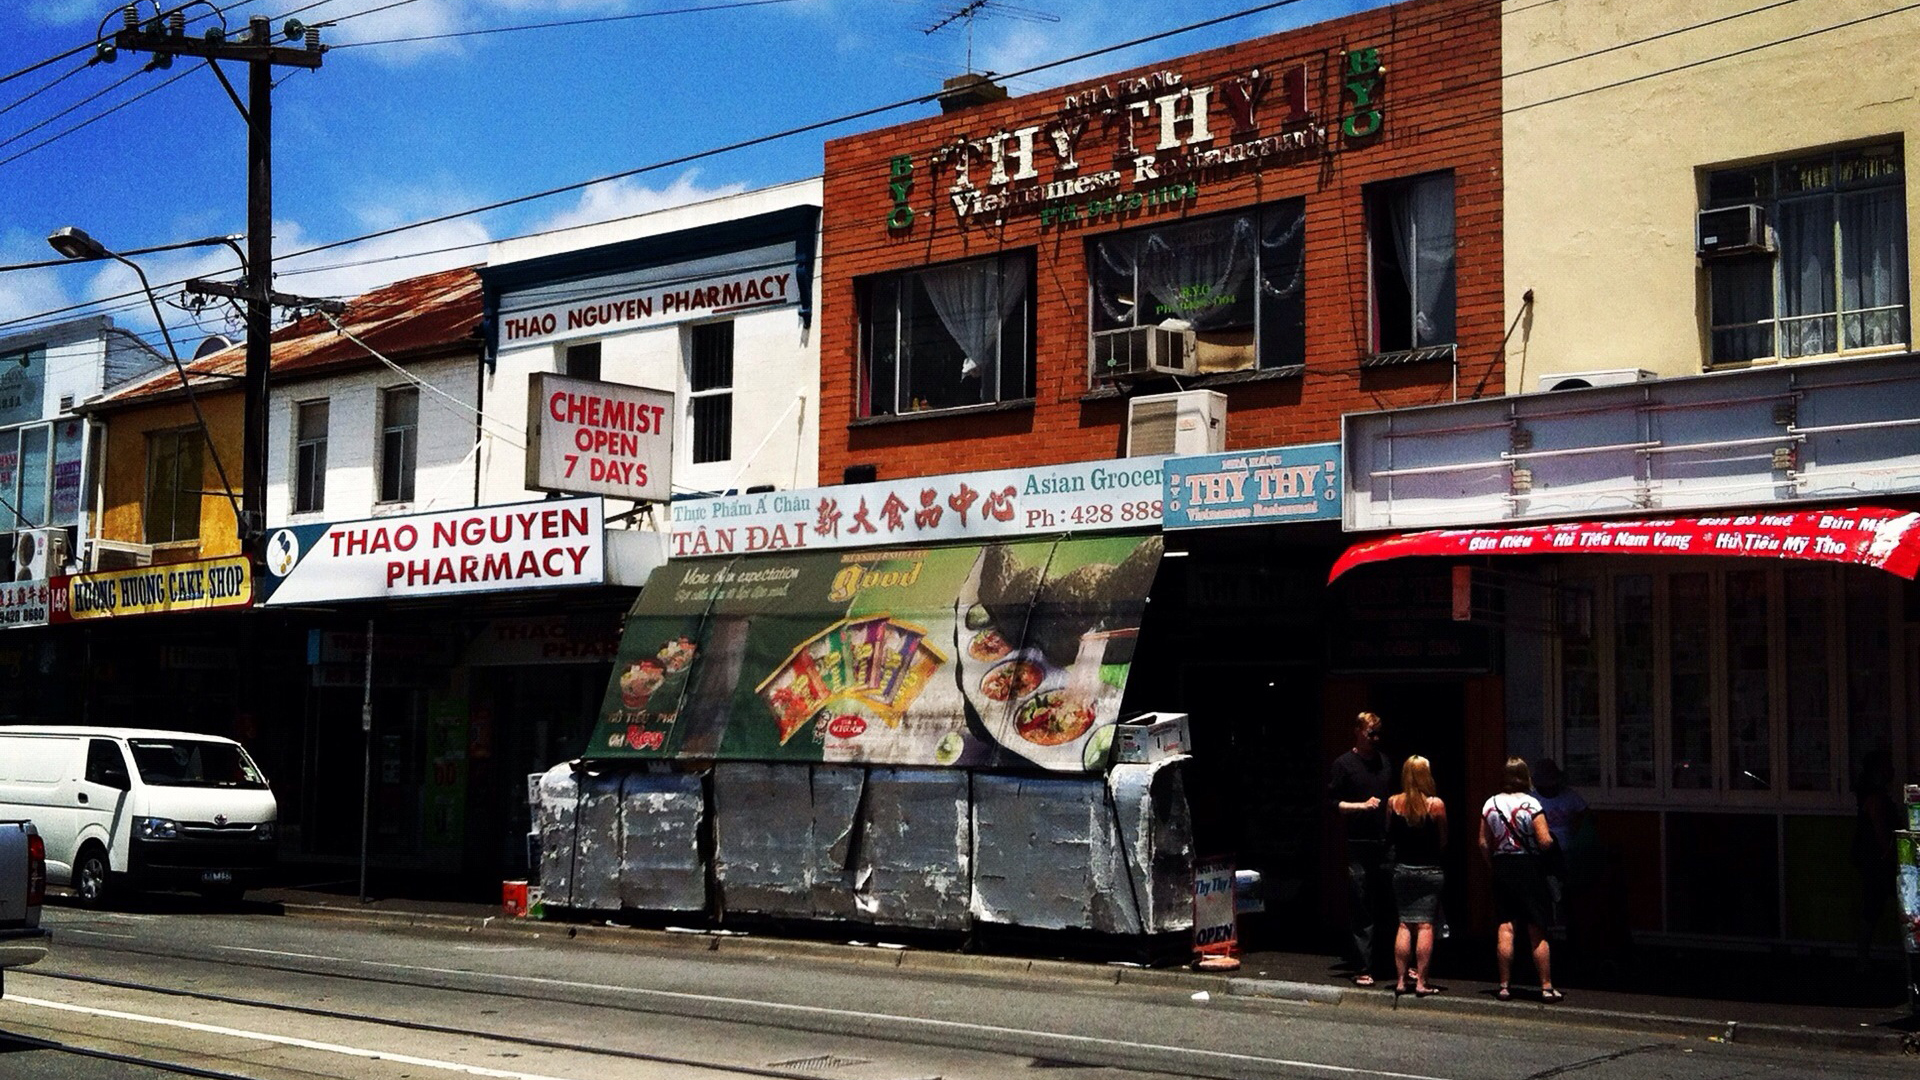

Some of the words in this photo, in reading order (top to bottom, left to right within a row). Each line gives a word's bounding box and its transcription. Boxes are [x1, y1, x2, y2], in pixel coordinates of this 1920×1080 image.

[940, 113, 1091, 193] THY
[505, 314, 556, 341] THAO
[568, 297, 653, 330] NGUYEN
[662, 273, 790, 315] PHARMACY
[549, 391, 665, 435] CHEMIST
[575, 428, 638, 458] OPEN
[564, 455, 579, 479] 7
[590, 457, 648, 488] DAYS
[1023, 472, 1086, 496] Asian
[1186, 471, 1250, 505] THY
[1254, 465, 1320, 500] THY
[774, 496, 810, 513] Châu
[814, 482, 1018, 539] 新大食品中心
[1071, 504, 1113, 524] 428
[330, 524, 418, 557] THAO
[433, 507, 589, 549] NGUYEN
[673, 525, 737, 556] TÂN
[1615, 533, 1649, 547] Nam
[1653, 532, 1692, 550] Vang
[1783, 536, 1810, 554] Mỹ
[387, 546, 590, 588] PHARMACY
[738, 566, 800, 585] expectation
[51, 588, 67, 612] 148
[74, 578, 116, 612] HUONG
[120, 574, 166, 607] HUONG
[168, 569, 205, 602] CAKE
[209, 565, 244, 599] SHOP
[1196, 924, 1233, 946] OPEN
